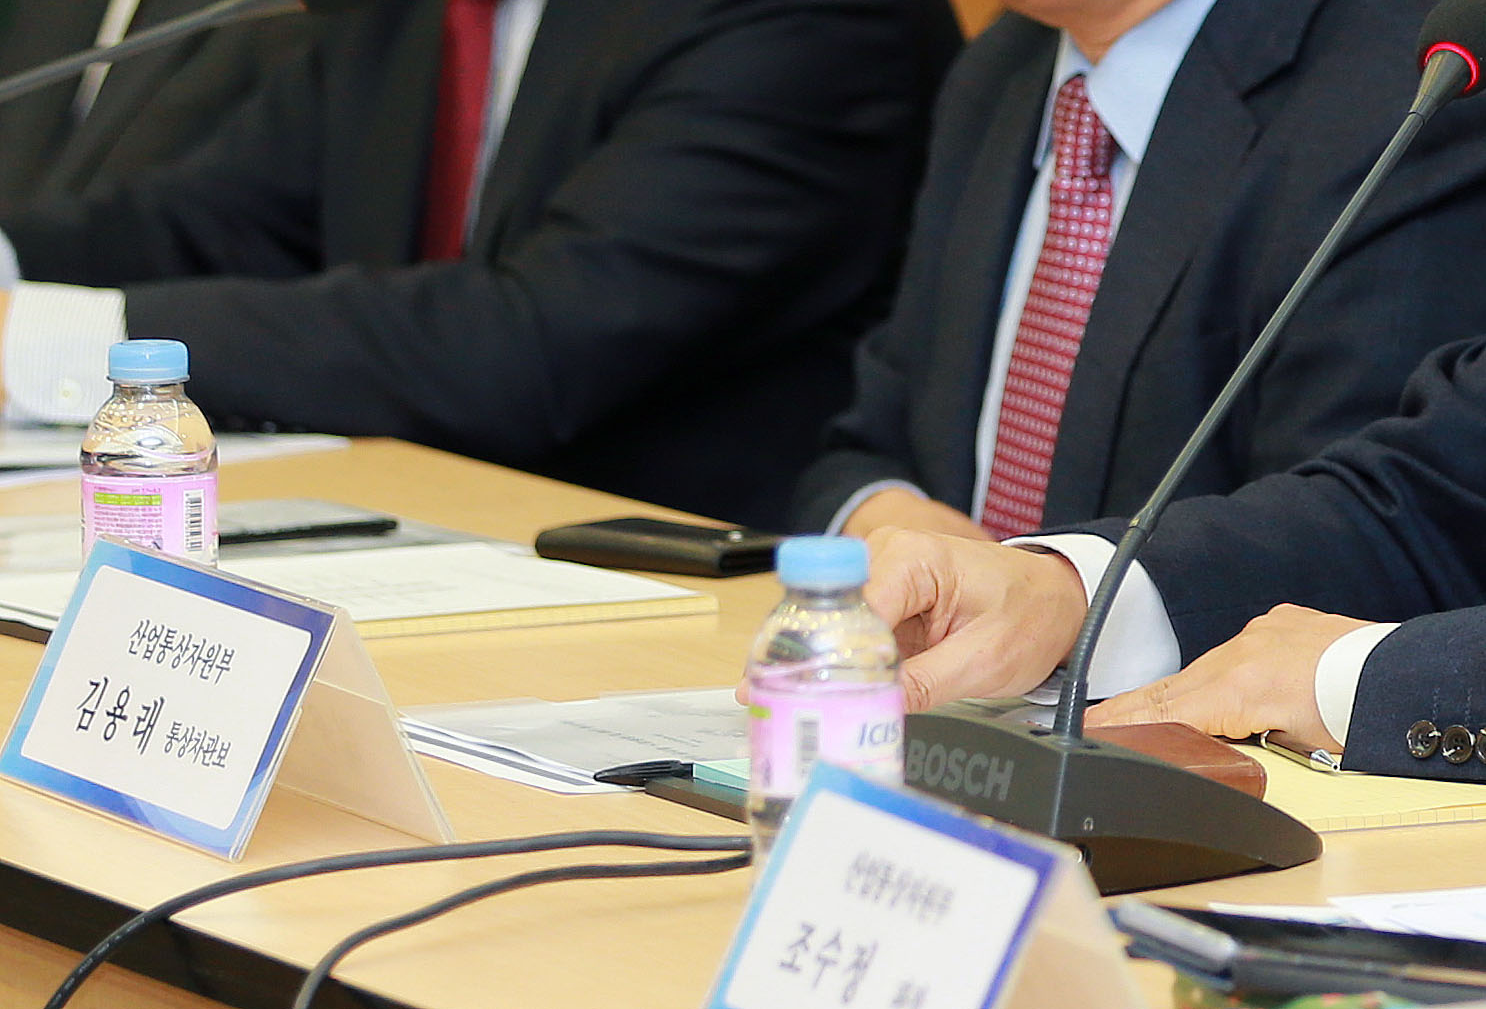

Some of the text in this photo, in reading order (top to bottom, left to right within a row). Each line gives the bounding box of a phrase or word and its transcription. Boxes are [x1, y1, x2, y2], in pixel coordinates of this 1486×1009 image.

[128, 619, 235, 685] 산업통상자원부
[164, 720, 231, 768] 통상차관보
[905, 739, 1014, 801] BOSCH
